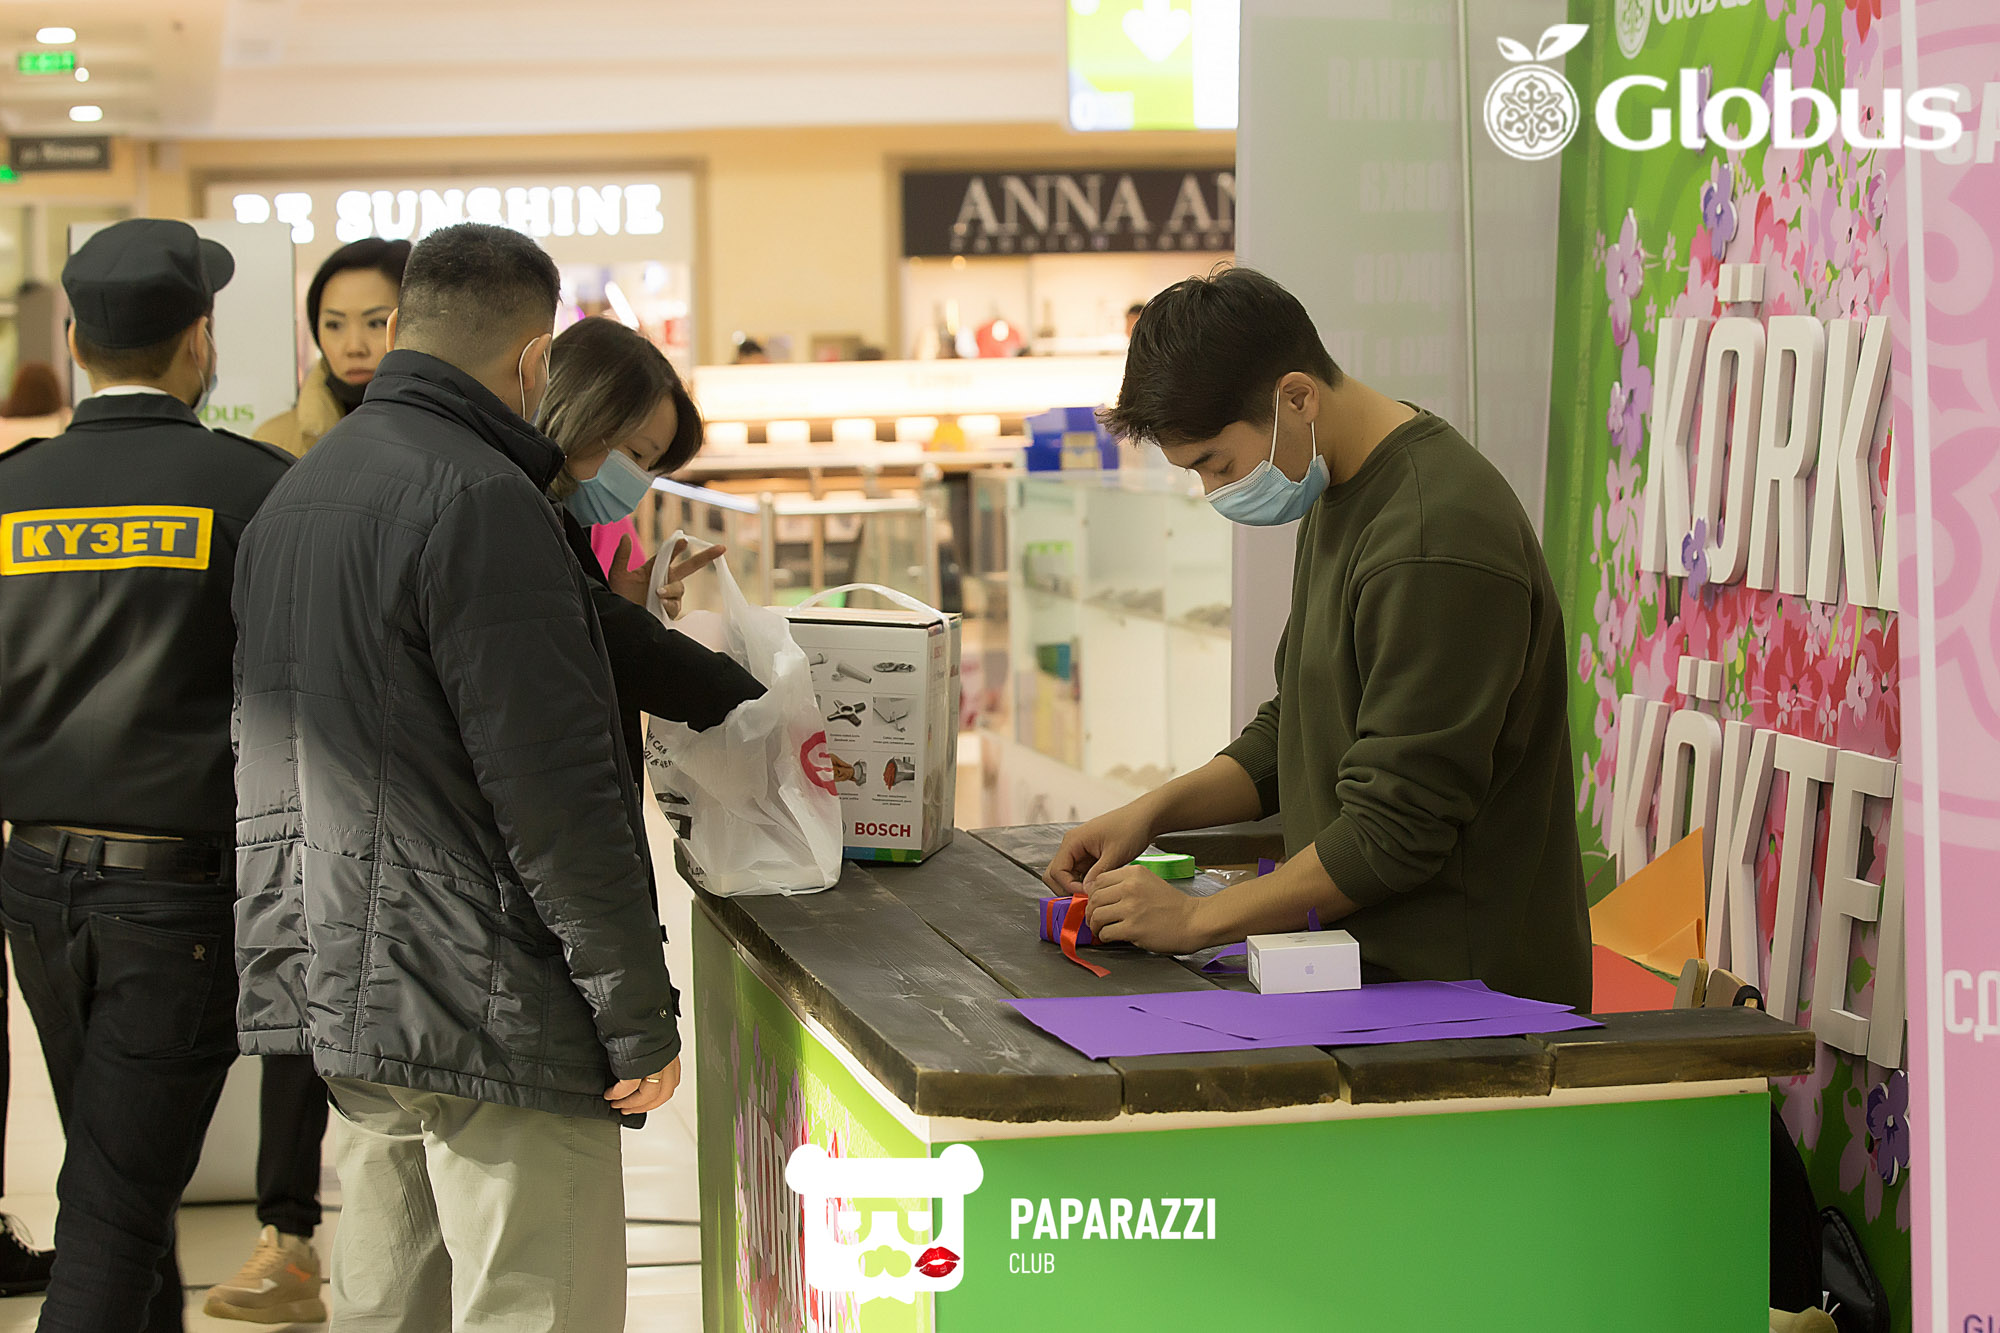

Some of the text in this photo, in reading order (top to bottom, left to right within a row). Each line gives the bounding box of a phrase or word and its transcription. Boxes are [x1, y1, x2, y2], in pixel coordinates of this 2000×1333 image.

[336, 184, 664, 242] SUNSHINE
[955, 174, 1150, 235] ANNA
[1641, 263, 1899, 612] KÖRK
[855, 822, 911, 837] BOSCH
[1612, 655, 1904, 1070] KÖKTE
